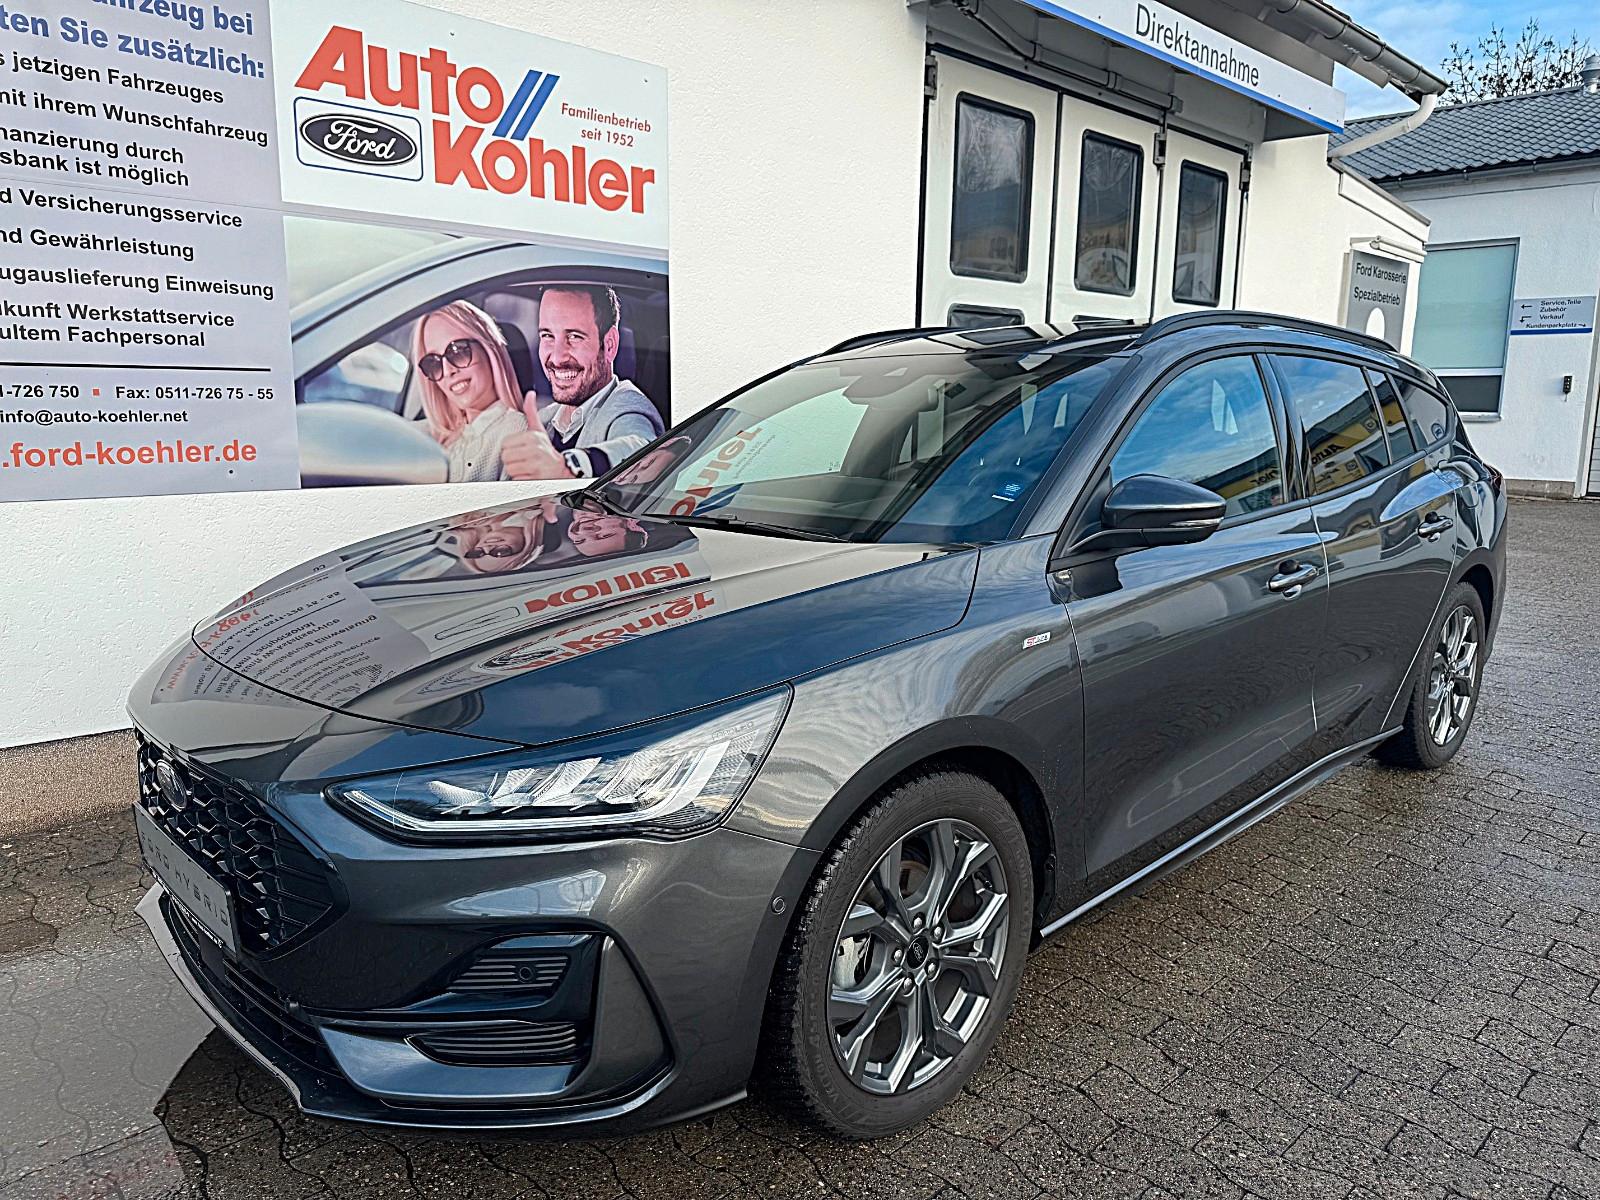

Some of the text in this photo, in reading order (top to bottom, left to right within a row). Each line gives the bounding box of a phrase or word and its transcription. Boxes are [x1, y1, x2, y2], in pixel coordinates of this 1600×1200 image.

[213, 6, 253, 35] bei
[60, 16, 109, 48] Sie
[117, 33, 265, 78] zusätzlich:
[1136, 3, 1260, 87] Direktannahme
[12, 51, 100, 82] jetzigen
[107, 68, 224, 103] Fahrzeuges
[294, 25, 504, 124] Auto
[34, 92, 96, 118] ihrem
[103, 103, 268, 147] Wunschfahrzeug
[561, 102, 652, 132] Familienbetrieb
[323, 120, 396, 160] Ford
[581, 125, 634, 148] seit 1952
[0, 148, 189, 186] sbank ist möglich
[126, 142, 184, 163] durch
[19, 188, 243, 227] Versicherungsservice
[30, 228, 195, 262] Gewährleistung
[1355, 262, 1407, 284] Ford Karosserie
[166, 275, 274, 301] Einweisung
[1354, 286, 1401, 306] Spezialbetrieb
[0, 300, 235, 327] kunft Werkstattservice
[68, 326, 205, 348] Fachpersonal
[49, 384, 80, 398] 750
[115, 386, 150, 399] Fax:
[155, 386, 222, 400] 0511-726
[226, 387, 244, 400] 75
[257, 387, 274, 400] 55
[0, 409, 189, 426] info@auto-koehler.net
